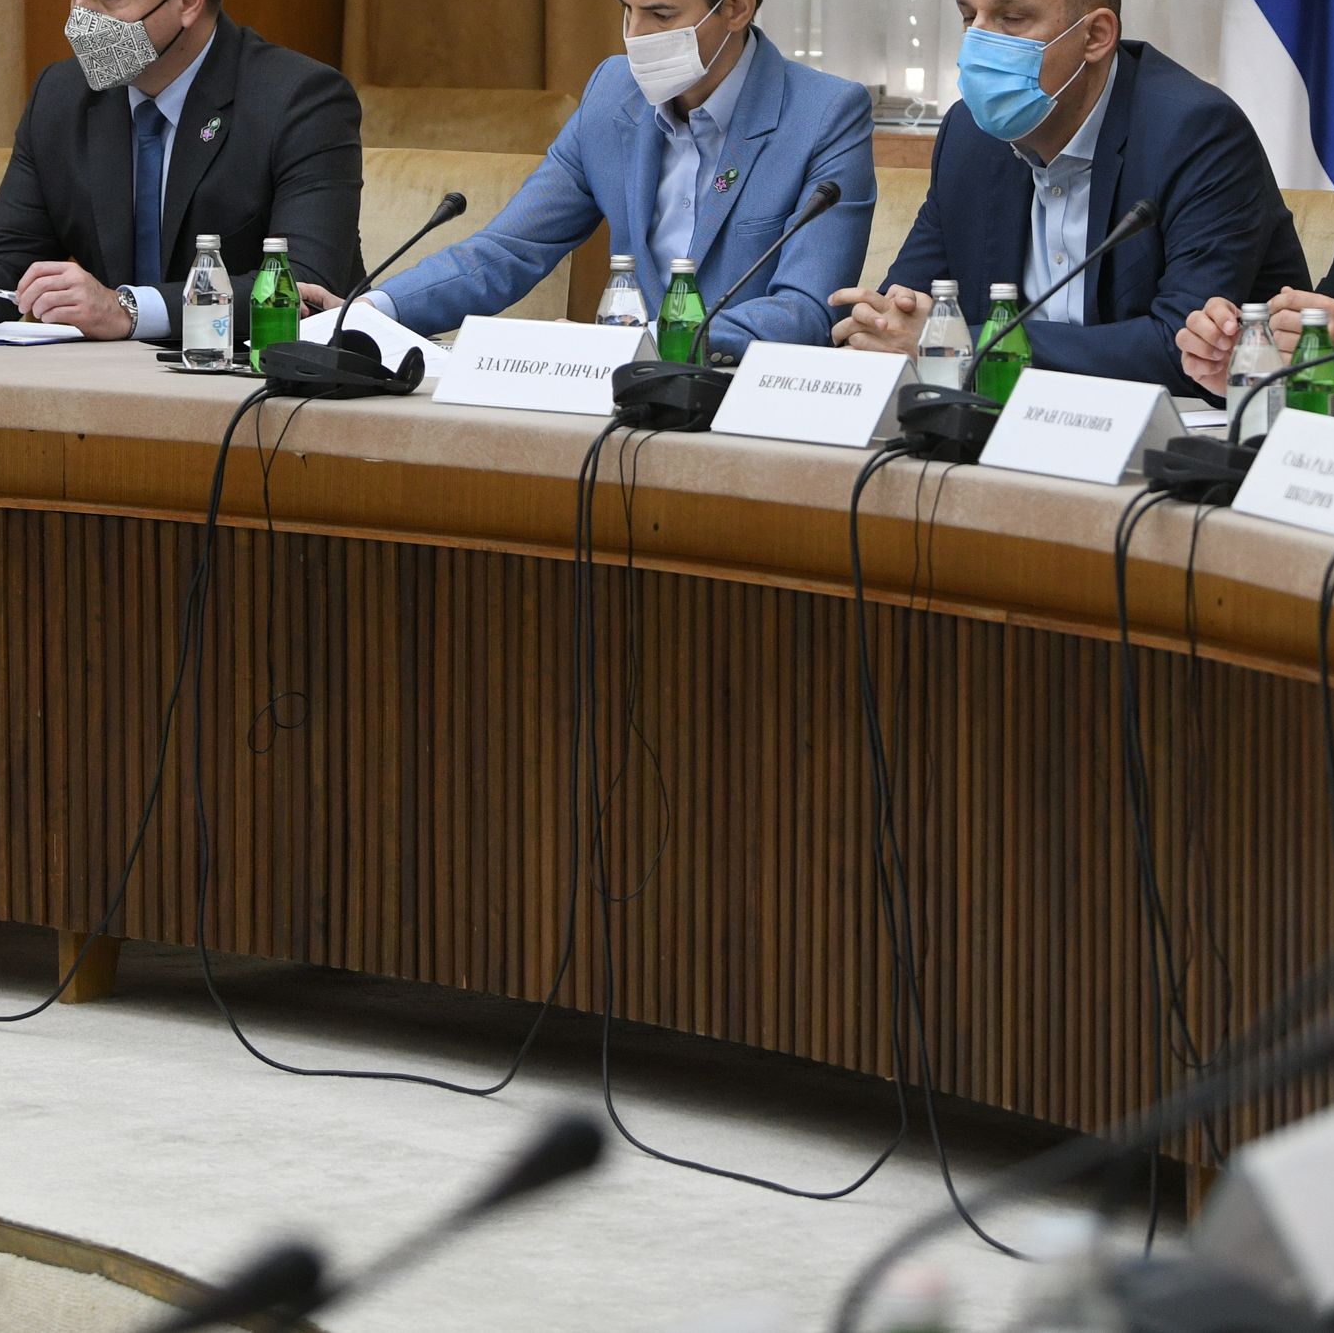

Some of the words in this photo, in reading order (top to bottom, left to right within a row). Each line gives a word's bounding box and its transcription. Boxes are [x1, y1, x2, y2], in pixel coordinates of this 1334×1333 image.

[475, 356, 549, 375] ЗЛАТИБОР
[548, 362, 611, 380] ЛОНЧАР
[758, 374, 821, 393] БЕРИСЛАВ
[821, 380, 863, 396] ВЕКИЋ
[1023, 405, 1058, 423] ЗОРАН
